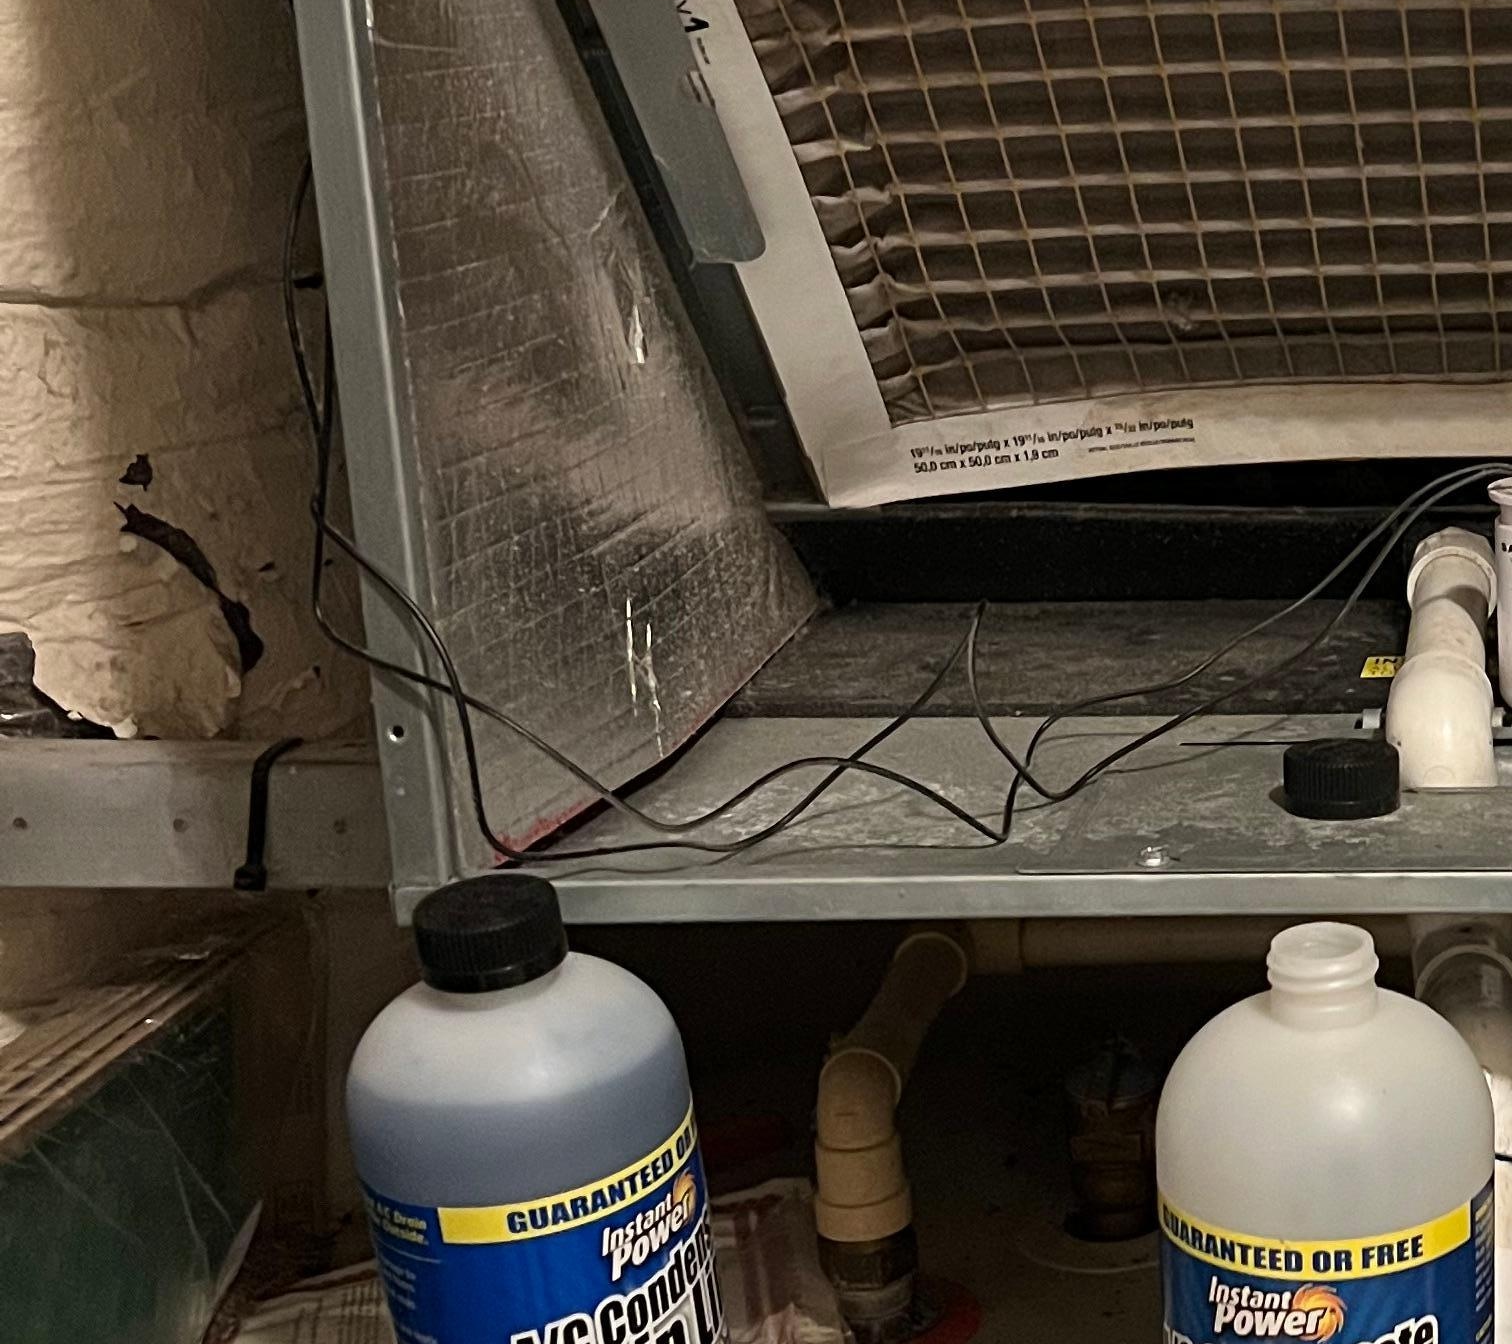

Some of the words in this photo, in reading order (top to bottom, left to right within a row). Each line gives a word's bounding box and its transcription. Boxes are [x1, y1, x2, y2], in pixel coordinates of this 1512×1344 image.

[506, 1149, 674, 1234] GUARANTEED
[602, 1193, 672, 1257] Instant
[612, 1194, 690, 1282] Power
[1162, 1202, 1303, 1273] GUARANTEED
[1312, 1250, 1353, 1273] OR
[1361, 1234, 1424, 1271] FREE
[1208, 1276, 1294, 1309] Instant
[1214, 1303, 1326, 1337] Power
